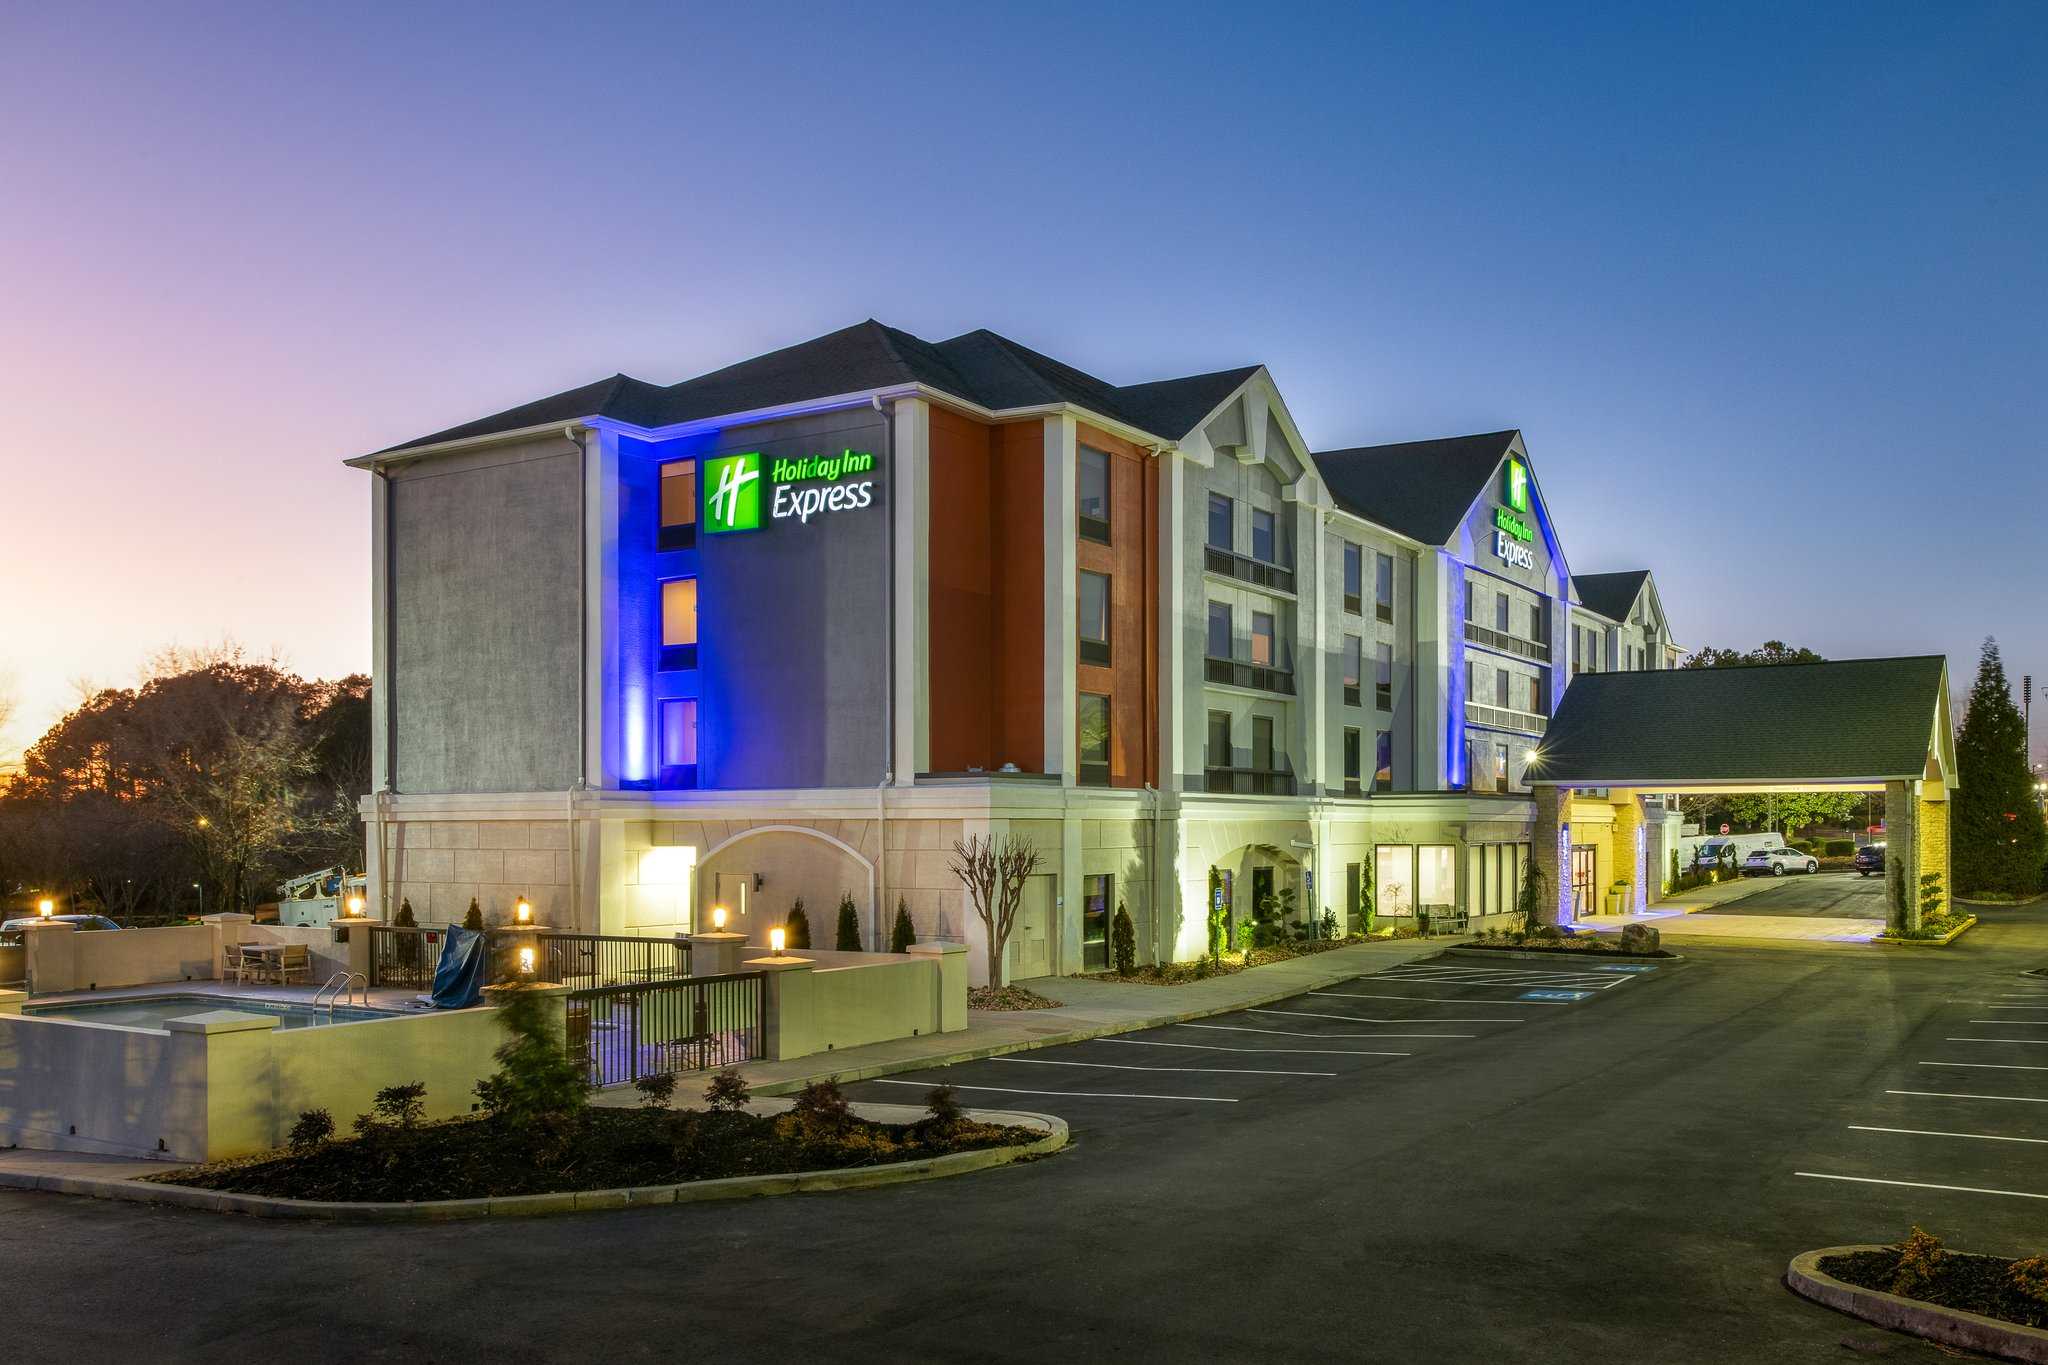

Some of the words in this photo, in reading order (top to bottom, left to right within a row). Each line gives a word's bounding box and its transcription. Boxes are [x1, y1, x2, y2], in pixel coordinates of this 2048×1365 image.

[772, 455, 839, 482] Holiday
[842, 449, 872, 473] Inn
[772, 481, 872, 523] Express
[1497, 508, 1522, 542] Holiday
[1522, 522, 1533, 542] Inn
[1497, 531, 1533, 570] Express
